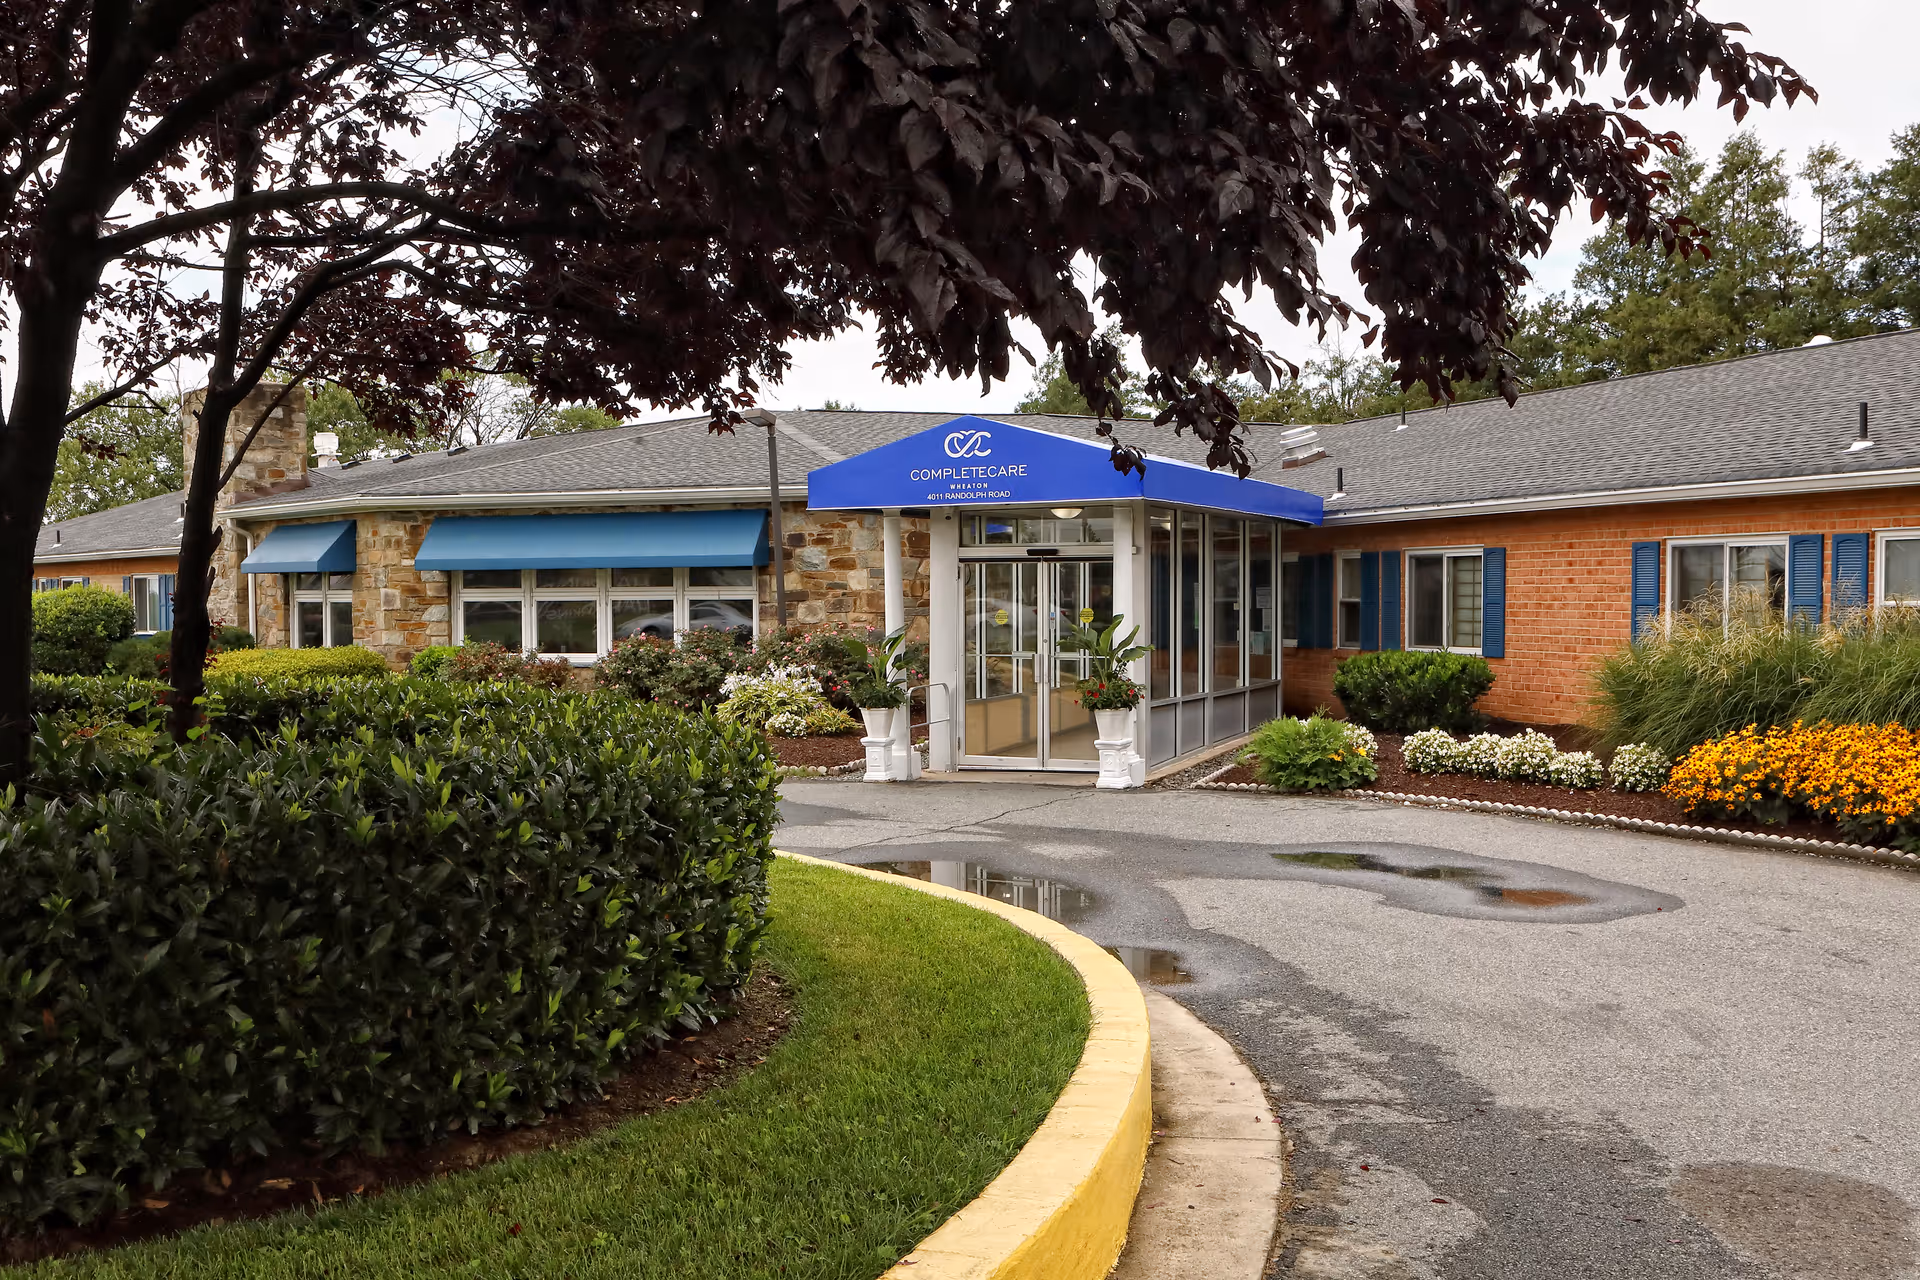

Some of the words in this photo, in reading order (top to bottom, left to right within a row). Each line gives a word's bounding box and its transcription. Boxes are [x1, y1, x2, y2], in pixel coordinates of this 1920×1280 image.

[910, 464, 1028, 481] COMPLETECARE
[949, 482, 988, 490] WHEATON
[945, 491, 987, 500] RANDOLPH
[988, 490, 1011, 498] ROAD
